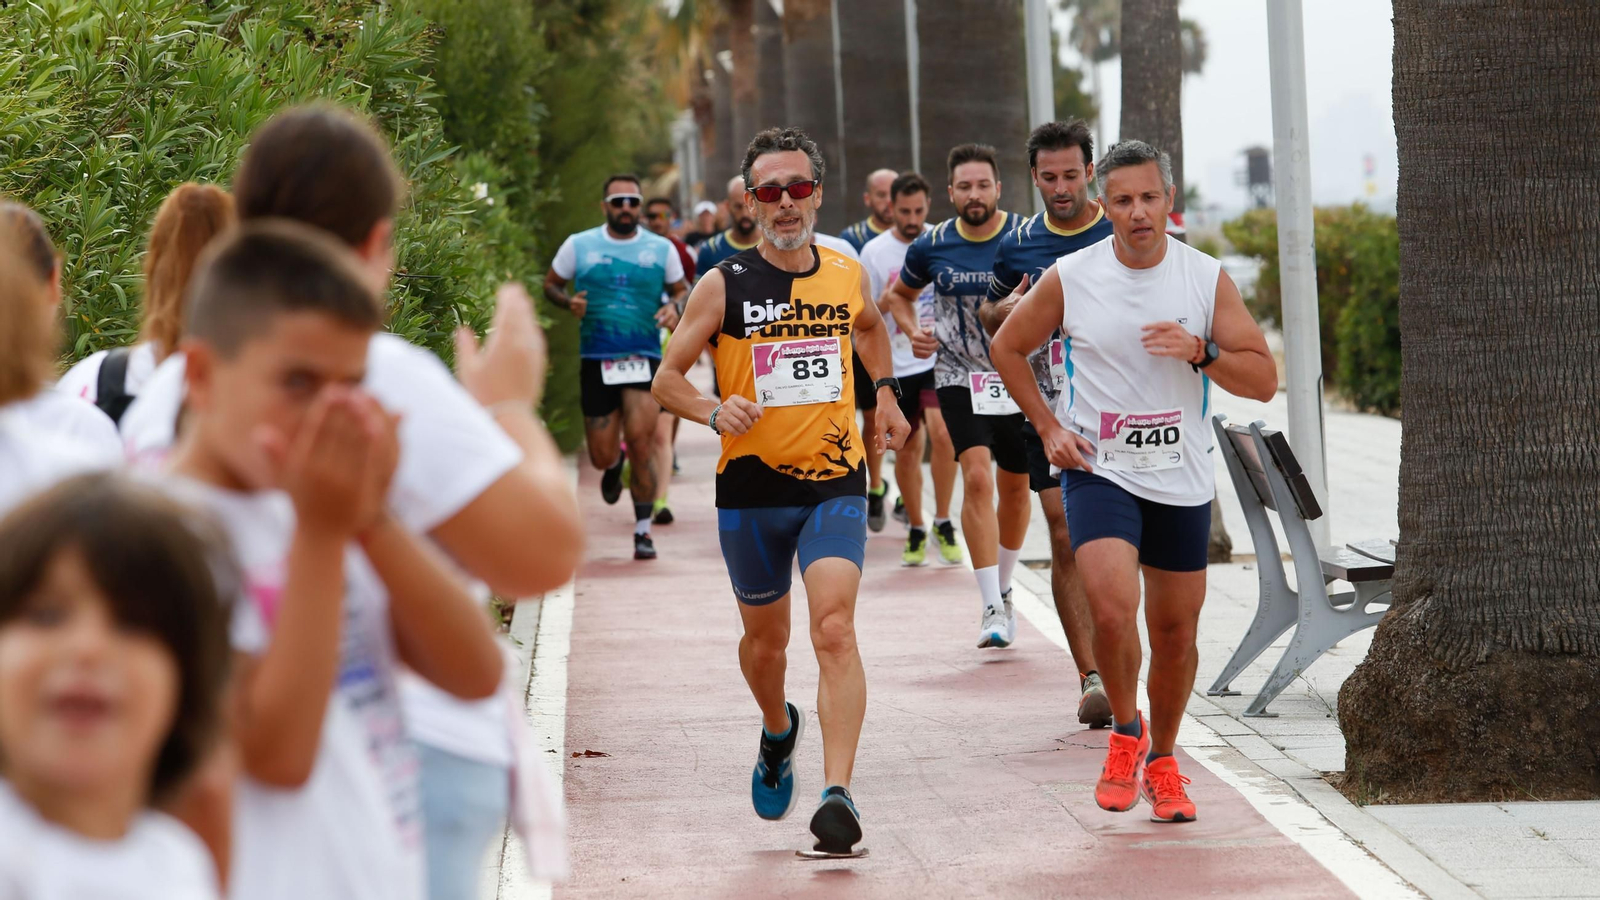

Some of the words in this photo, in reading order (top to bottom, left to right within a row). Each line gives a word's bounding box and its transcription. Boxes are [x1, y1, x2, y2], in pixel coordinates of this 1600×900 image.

[743, 299, 851, 323] bichos
[744, 322, 850, 339] runners
[792, 358, 829, 380] 83
[1125, 426, 1180, 448] 440
[742, 590, 778, 599] LURBEL
